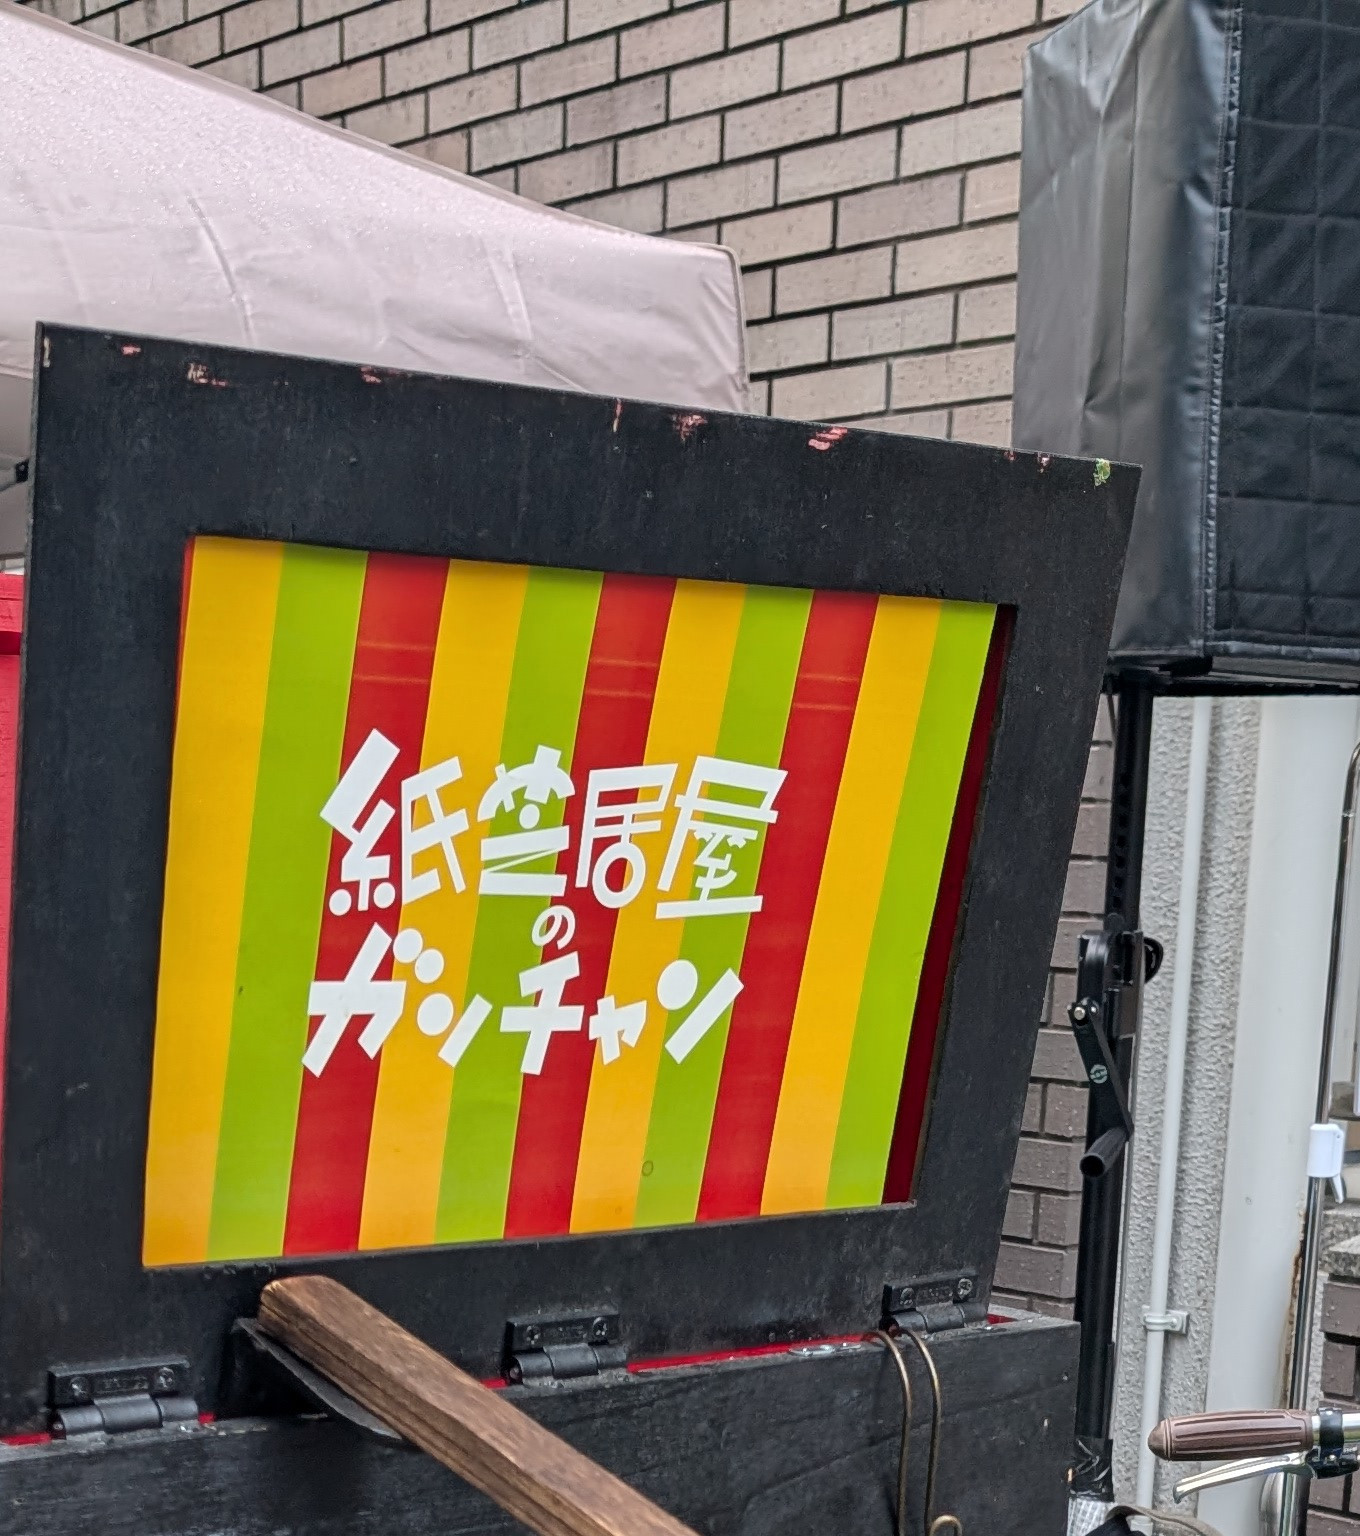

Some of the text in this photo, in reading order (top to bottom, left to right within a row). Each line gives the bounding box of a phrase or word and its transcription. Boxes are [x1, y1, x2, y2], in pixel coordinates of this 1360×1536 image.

[321, 729, 788, 919] 紙芝居屋
[303, 923, 744, 1078] ガンチャン
[532, 906, 576, 949] の
